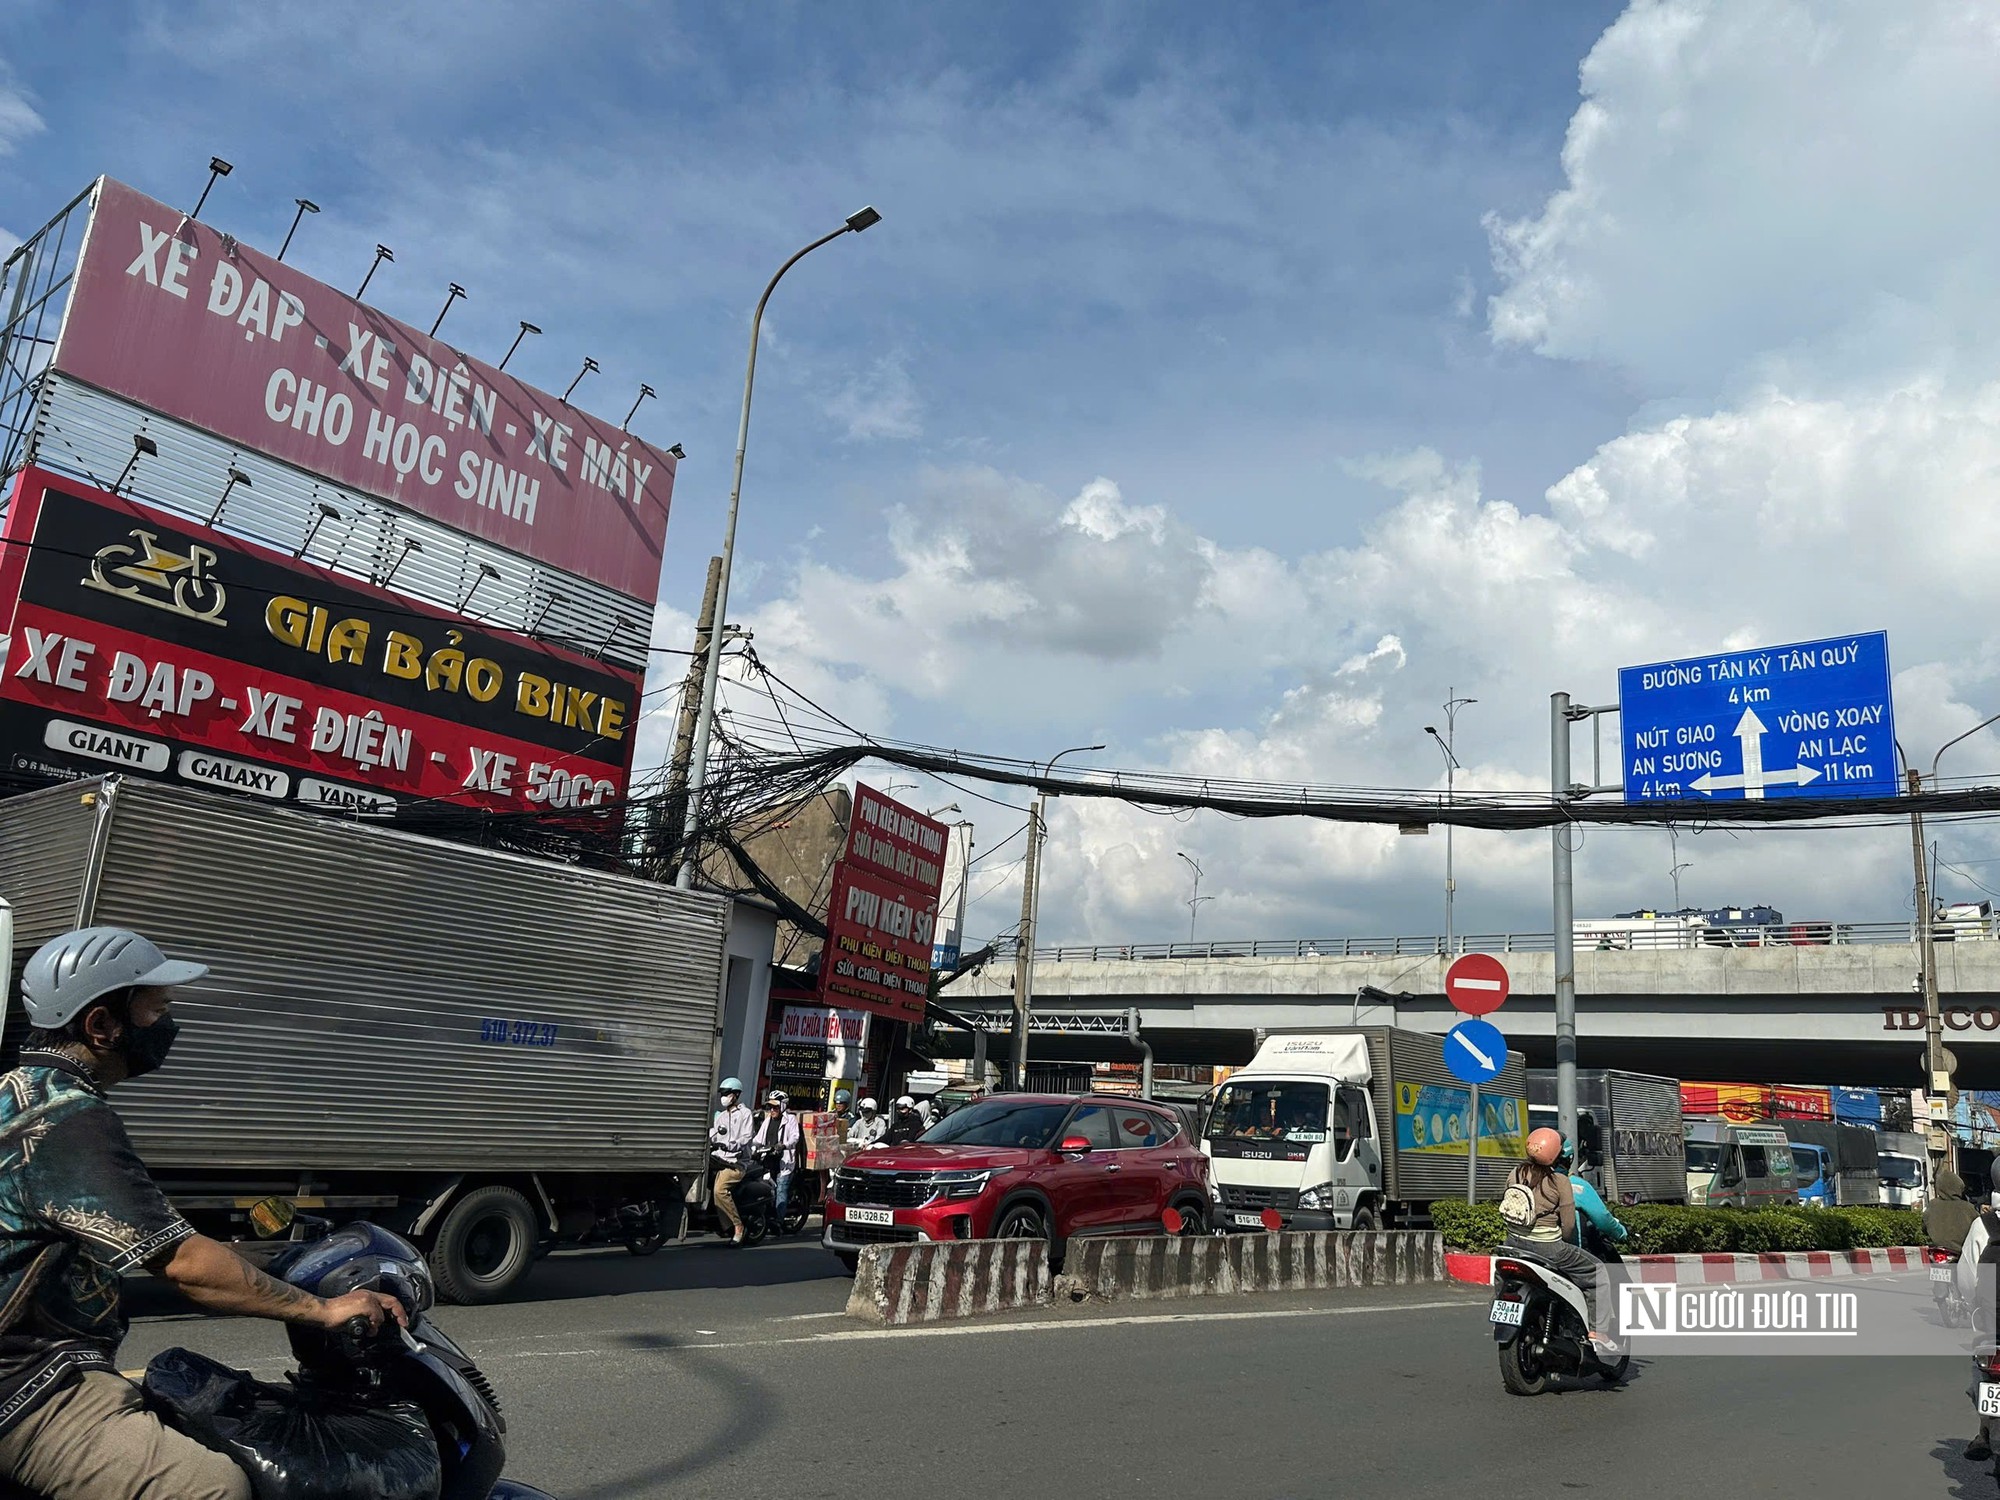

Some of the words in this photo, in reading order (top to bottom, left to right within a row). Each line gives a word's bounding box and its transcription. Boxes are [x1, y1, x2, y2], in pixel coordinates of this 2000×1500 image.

[126, 221, 198, 299] XE
[207, 265, 305, 342] ĐẠP
[338, 323, 396, 391] XE
[406, 350, 498, 437] ĐIỆN
[524, 410, 573, 471] XE
[581, 441, 654, 505] MÁY
[265, 368, 354, 446] CHO
[362, 409, 447, 485] HỌC
[454, 457, 542, 526] SINH
[265, 595, 370, 667] GIA
[382, 629, 503, 702] BẢO
[515, 671, 626, 741] BIKE
[1642, 664, 1702, 690] ĐƯỜNG
[1708, 660, 1744, 681] TÂN
[1748, 653, 1771, 676] KỲ
[1778, 649, 1816, 672] TÂN
[1821, 641, 1859, 664] QUÝ
[15, 626, 96, 693] XE
[106, 650, 215, 719] ĐẠP
[239, 686, 303, 743] XE
[310, 709, 412, 773] ĐIỆN
[462, 746, 514, 797] XE
[1728, 687, 1739, 704] 4
[1743, 686, 1771, 703] km
[1778, 710, 1830, 734] VÒNG
[1836, 704, 1884, 728] XOAY
[68, 728, 150, 764] GIANT
[1636, 725, 1670, 750] NÚT
[1676, 724, 1716, 745] GIAO
[1797, 739, 1823, 760] AN
[1829, 734, 1867, 758] LẠC
[190, 756, 278, 796] GALAXY
[1632, 757, 1656, 776] AN
[1662, 749, 1722, 773] SƯƠNG
[1824, 762, 1837, 782] 11
[1843, 762, 1874, 780] km
[1641, 781, 1652, 798] 4
[1654, 780, 1682, 797] km
[860, 795, 880, 830] PHỤ
[879, 805, 900, 838] KIỆN
[899, 814, 920, 847] ĐIỆN
[919, 824, 943, 858] THOẠI
[853, 828, 872, 859] SỬA
[872, 838, 896, 870] CHỮA
[895, 848, 917, 880] ĐIỆN
[916, 858, 940, 891] THOẠI
[844, 885, 880, 938] PHỤ
[878, 894, 914, 946] KIỆN
[913, 902, 938, 946] SỐ
[840, 936, 859, 954] PHỤ
[862, 941, 882, 960] KIỆN
[885, 947, 904, 967] ĐIỆN
[836, 957, 855, 978] SỬA
[857, 965, 881, 984] CHỮA
[883, 972, 902, 991] ĐIỆN
[1241, 1151, 1273, 1159] ISUZU
